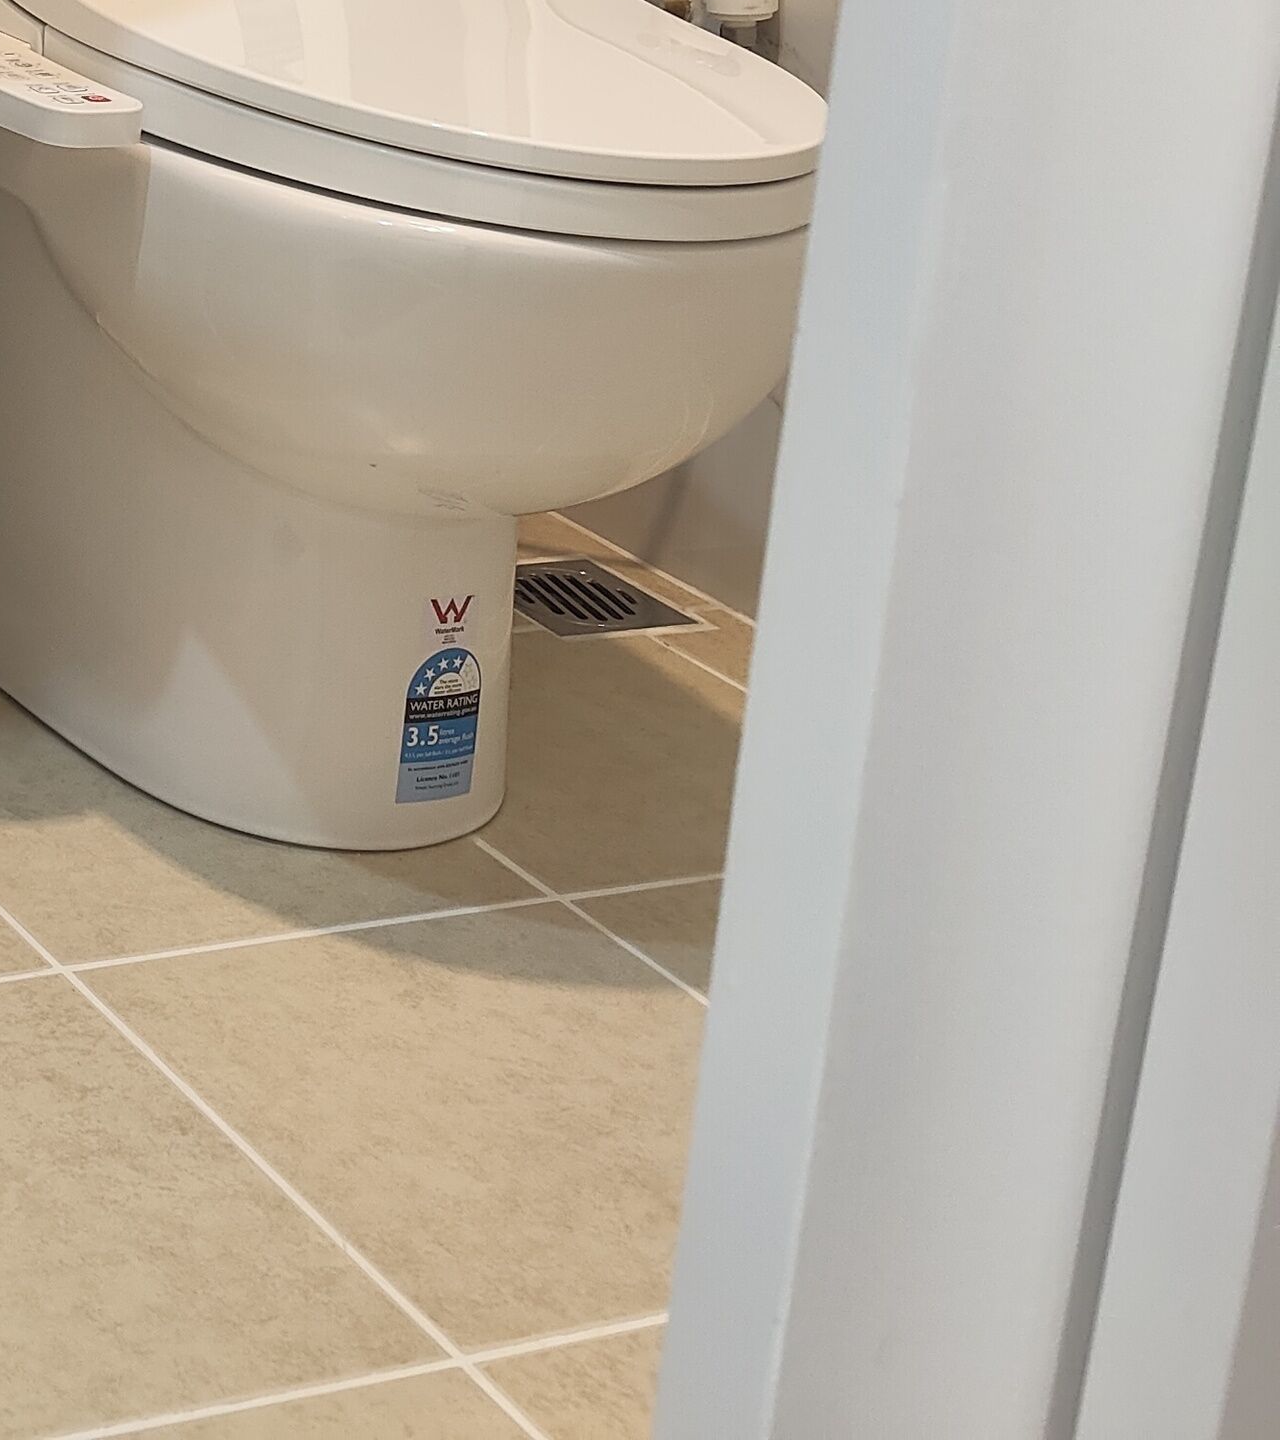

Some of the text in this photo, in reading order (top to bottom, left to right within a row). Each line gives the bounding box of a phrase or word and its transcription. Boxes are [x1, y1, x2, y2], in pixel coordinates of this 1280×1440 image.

[434, 626, 465, 635] WaterMark
[410, 693, 478, 712] WATER RATING
[406, 725, 440, 747] 3.5
